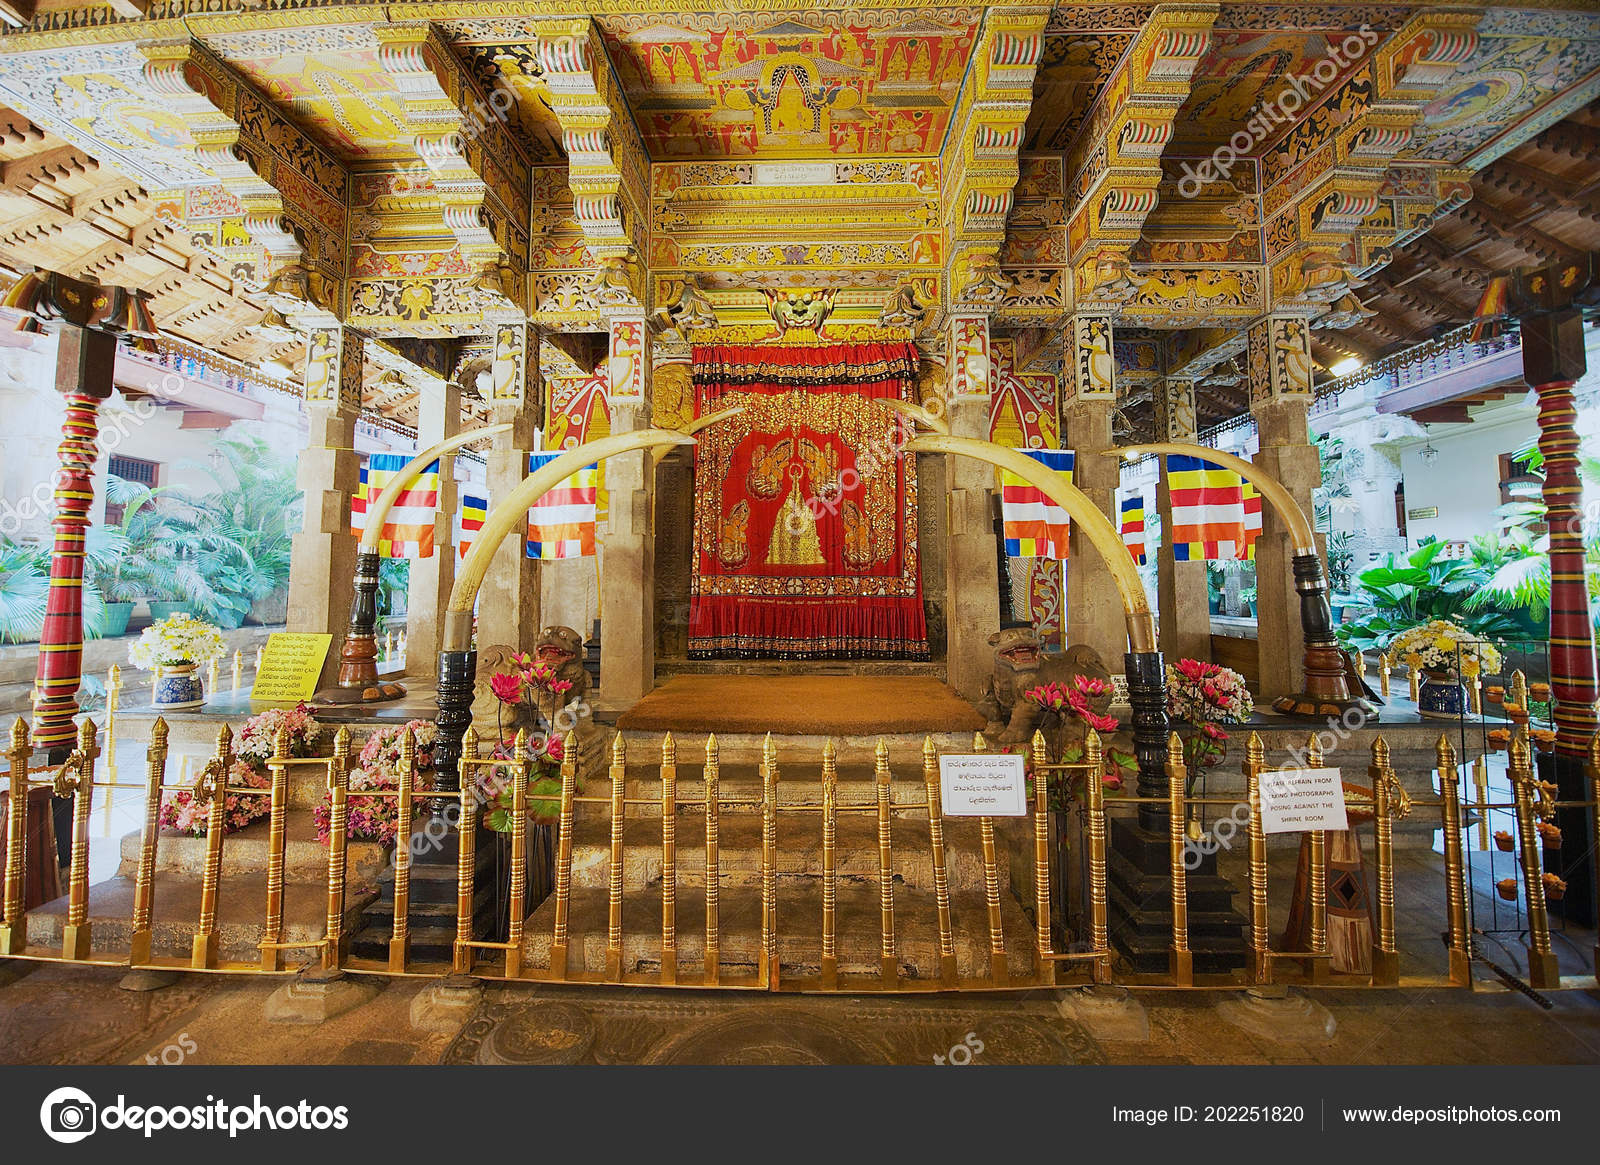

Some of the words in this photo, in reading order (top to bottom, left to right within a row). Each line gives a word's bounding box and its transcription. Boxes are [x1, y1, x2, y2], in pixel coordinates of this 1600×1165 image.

[1315, 777, 1332, 785] FROM
[1290, 790, 1335, 799] PHOTOGRAPHS
[1270, 804, 1292, 812] POSING
